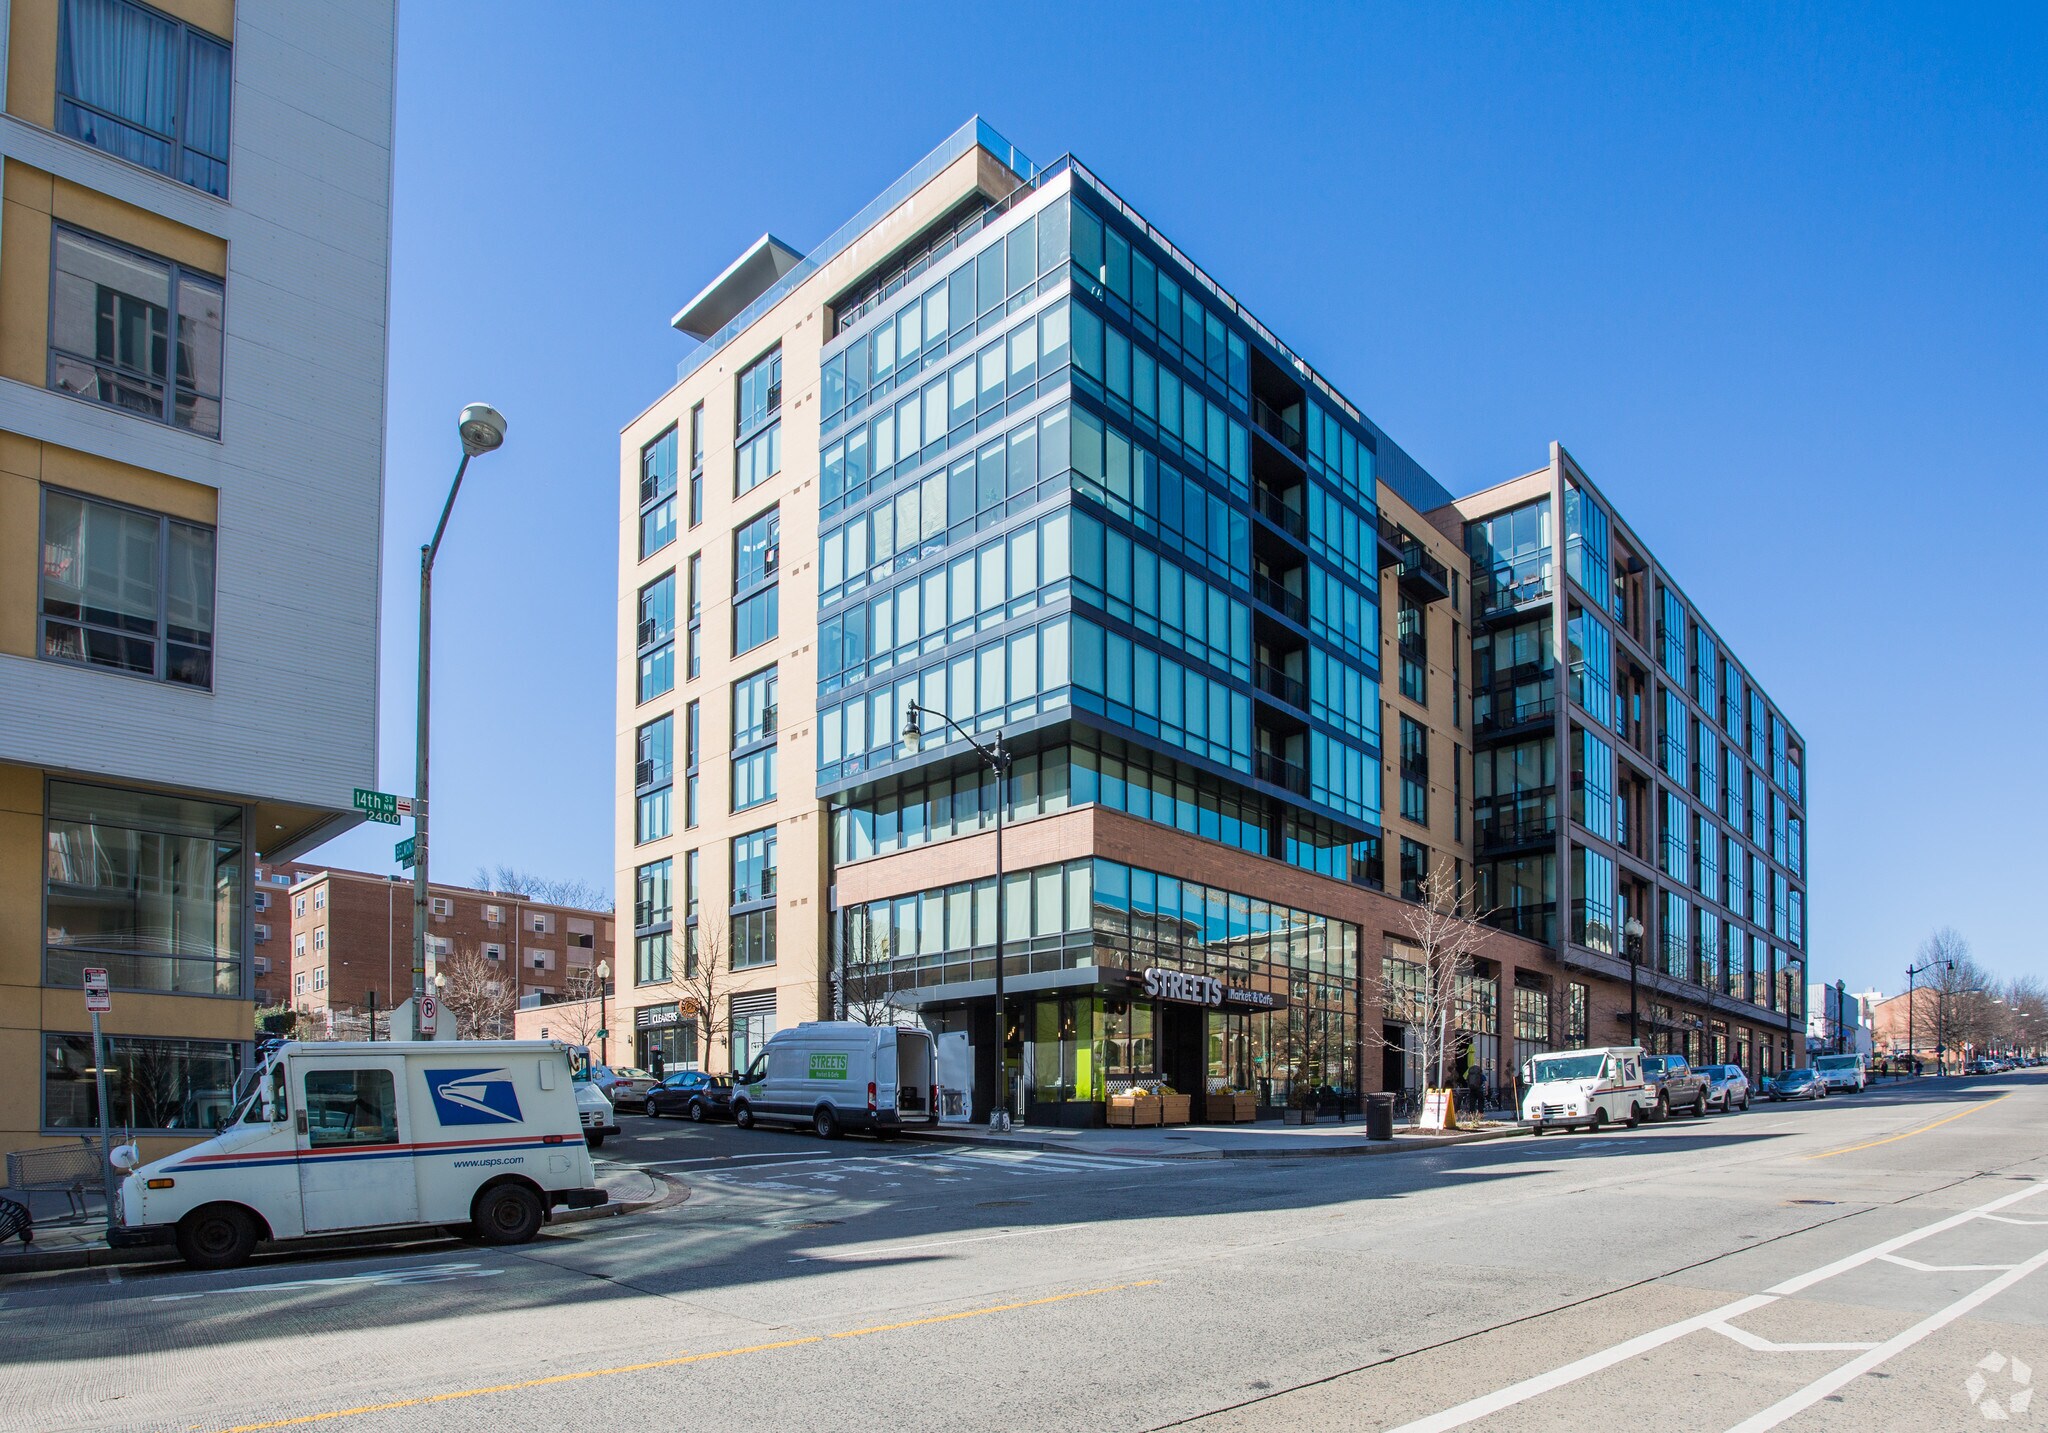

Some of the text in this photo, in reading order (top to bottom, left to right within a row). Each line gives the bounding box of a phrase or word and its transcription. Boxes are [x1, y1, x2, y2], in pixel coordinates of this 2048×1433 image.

[356, 792, 393, 809] 14th ST
[368, 811, 400, 824] 2400
[1144, 967, 1223, 1006] STREETS
[1228, 988, 1274, 1006] Market & Cafe
[811, 1055, 846, 1069] STREETS
[454, 1156, 524, 1168] www.usps.com
